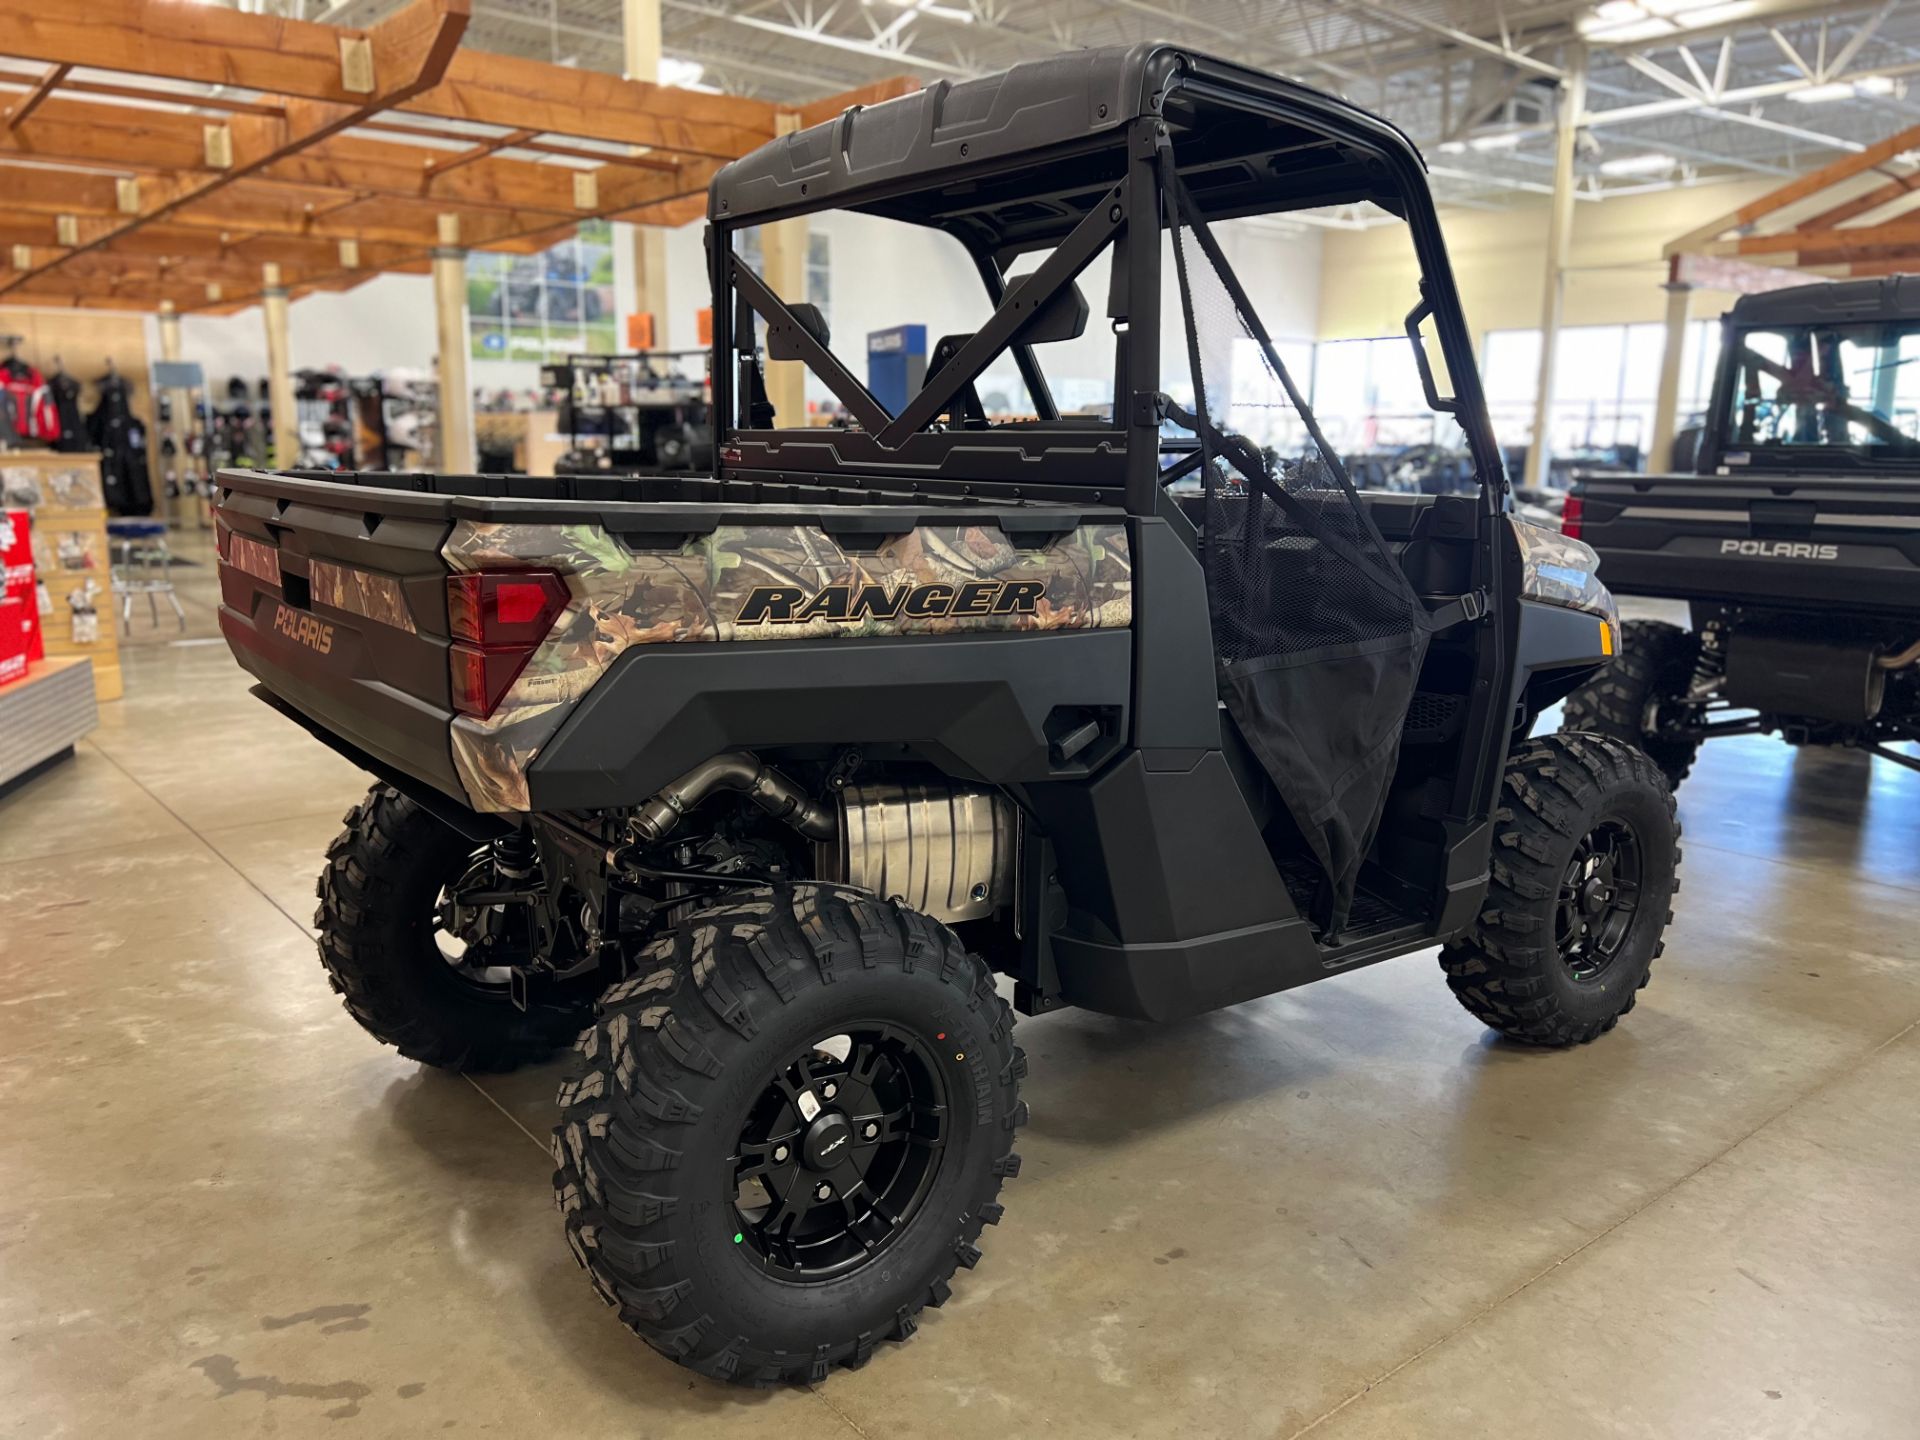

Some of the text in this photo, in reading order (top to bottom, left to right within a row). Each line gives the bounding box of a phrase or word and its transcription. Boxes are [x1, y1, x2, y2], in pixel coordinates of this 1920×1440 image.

[1721, 540, 1838, 560] POLARIS
[733, 580, 1046, 624] RANGER
[273, 604, 334, 654] POLARIS
